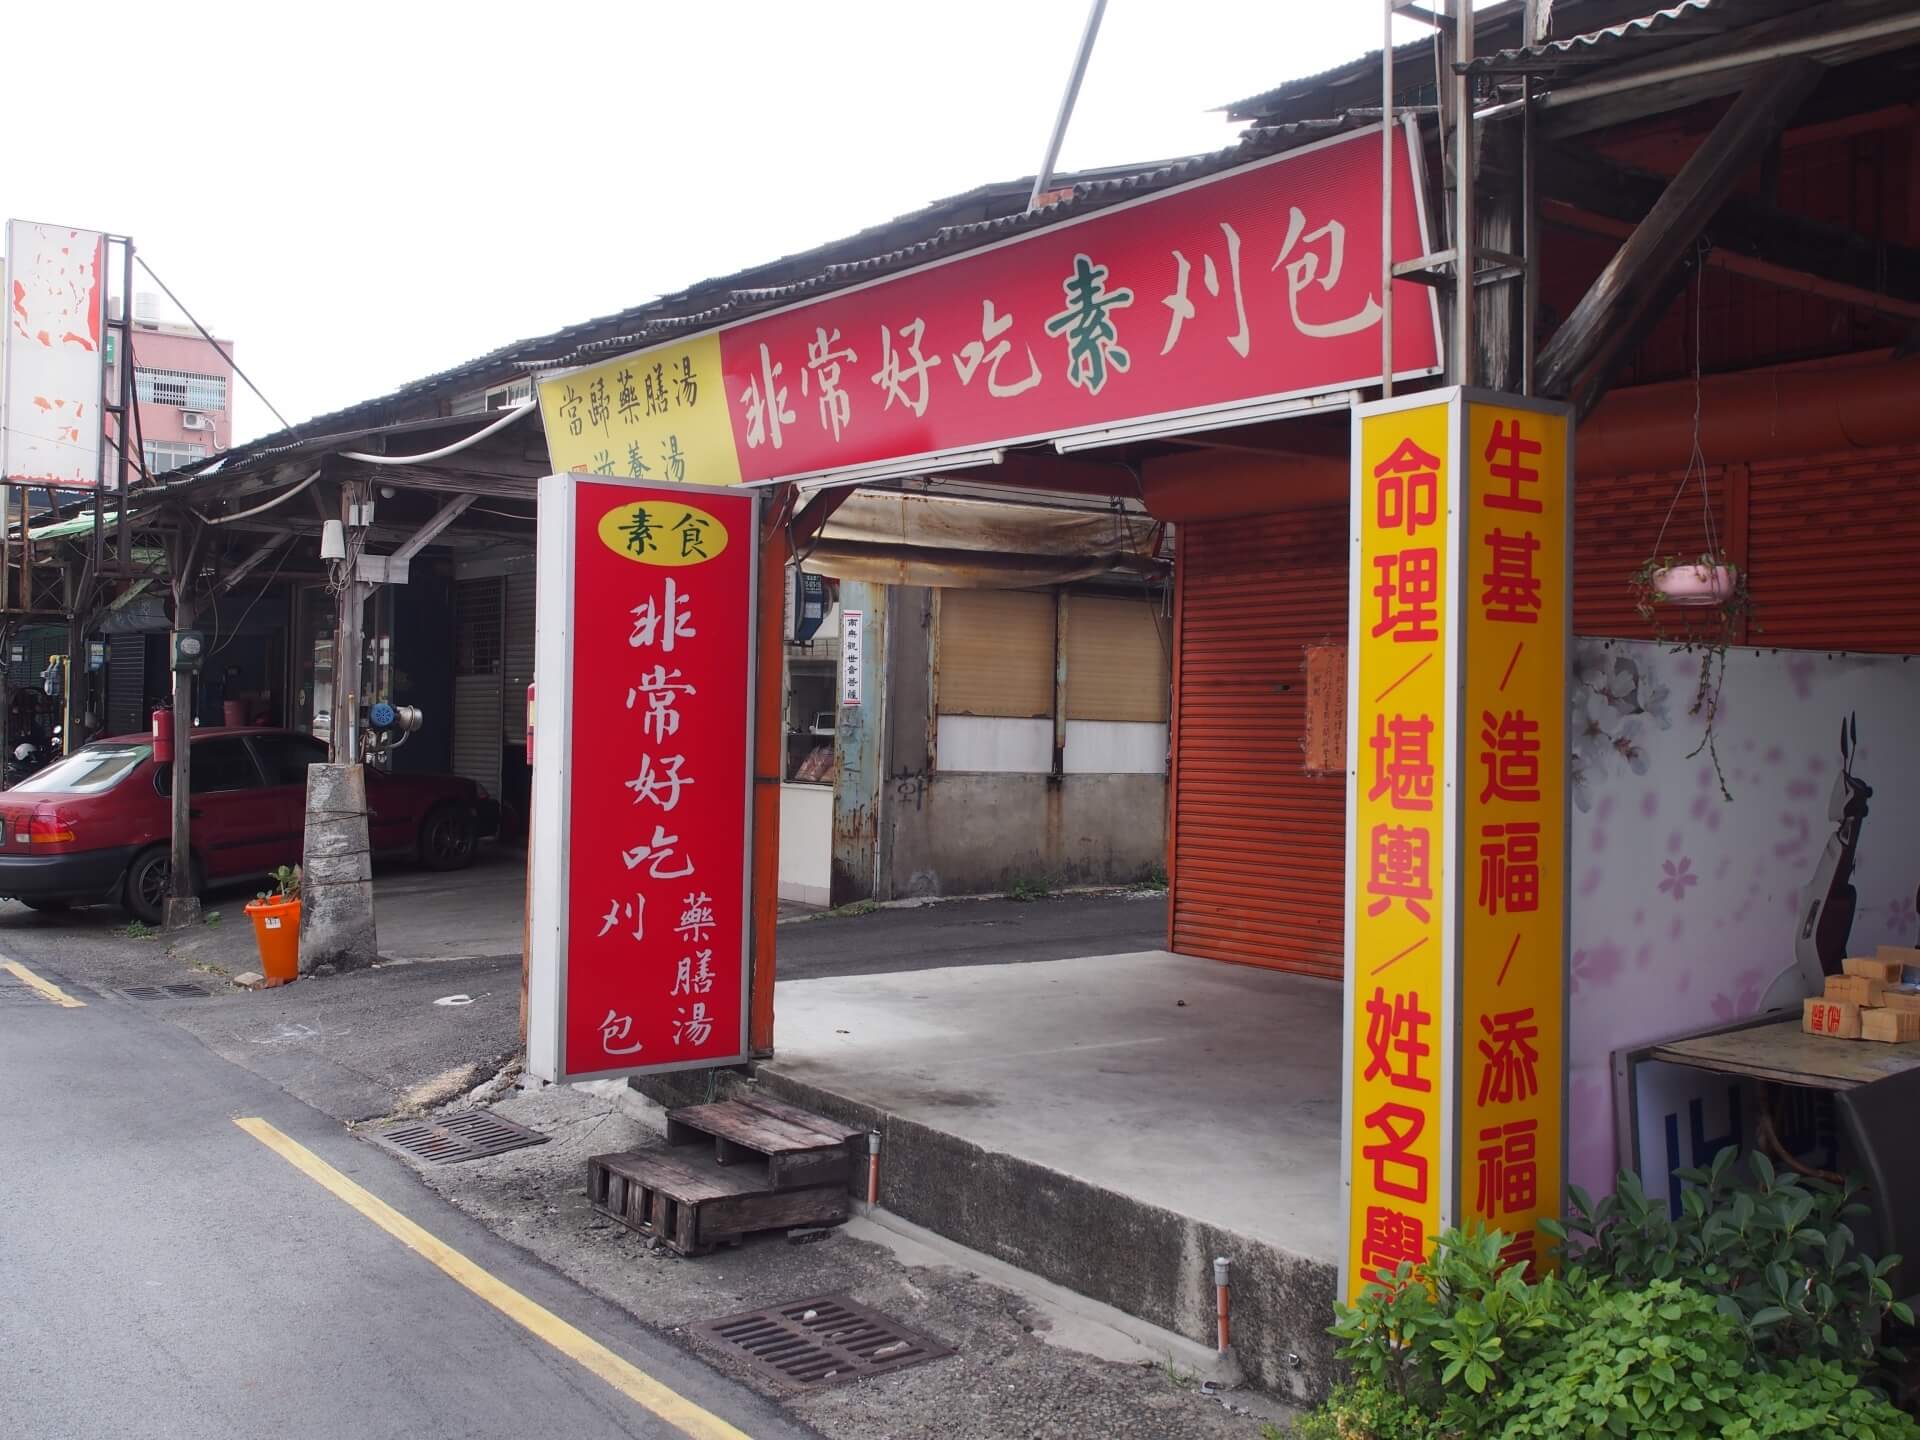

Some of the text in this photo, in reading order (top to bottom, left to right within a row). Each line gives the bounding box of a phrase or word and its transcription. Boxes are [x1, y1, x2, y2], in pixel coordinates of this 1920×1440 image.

[740, 206, 1384, 449] 非常好吃素刈包
[617, 507, 710, 559] 素食
[846, 618, 859, 700] 南無觀世音菩薩
[670, 890, 718, 1046] 藥膳湯
